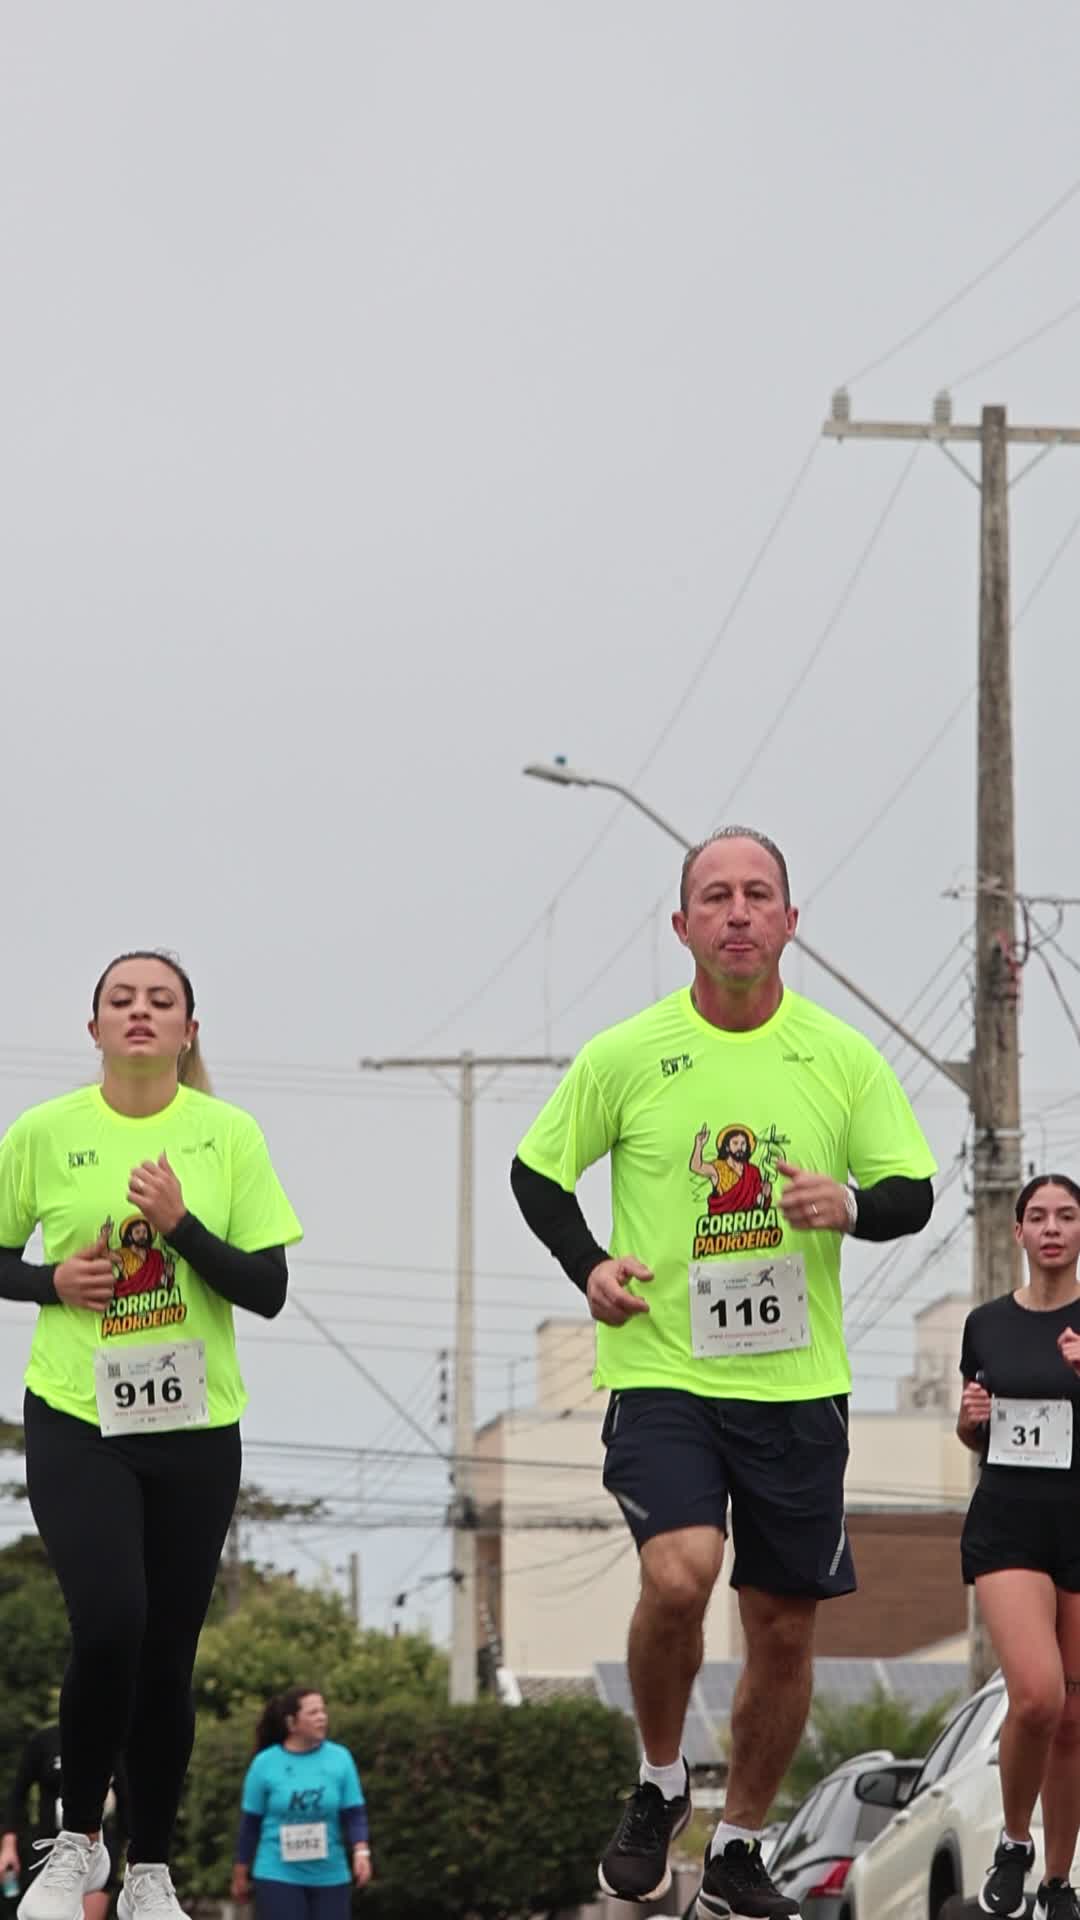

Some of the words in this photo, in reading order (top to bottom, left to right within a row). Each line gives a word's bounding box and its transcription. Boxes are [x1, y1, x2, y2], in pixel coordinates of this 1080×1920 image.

[697, 1207, 777, 1238] CORRIDA
[694, 1229, 782, 1258] PADROEIRO
[105, 1286, 184, 1318] CORRIDA
[710, 1295, 781, 1328] 116
[102, 1304, 186, 1337] PADROEIRO
[114, 1377, 182, 1408] 916
[1012, 1426, 1041, 1446] 31
